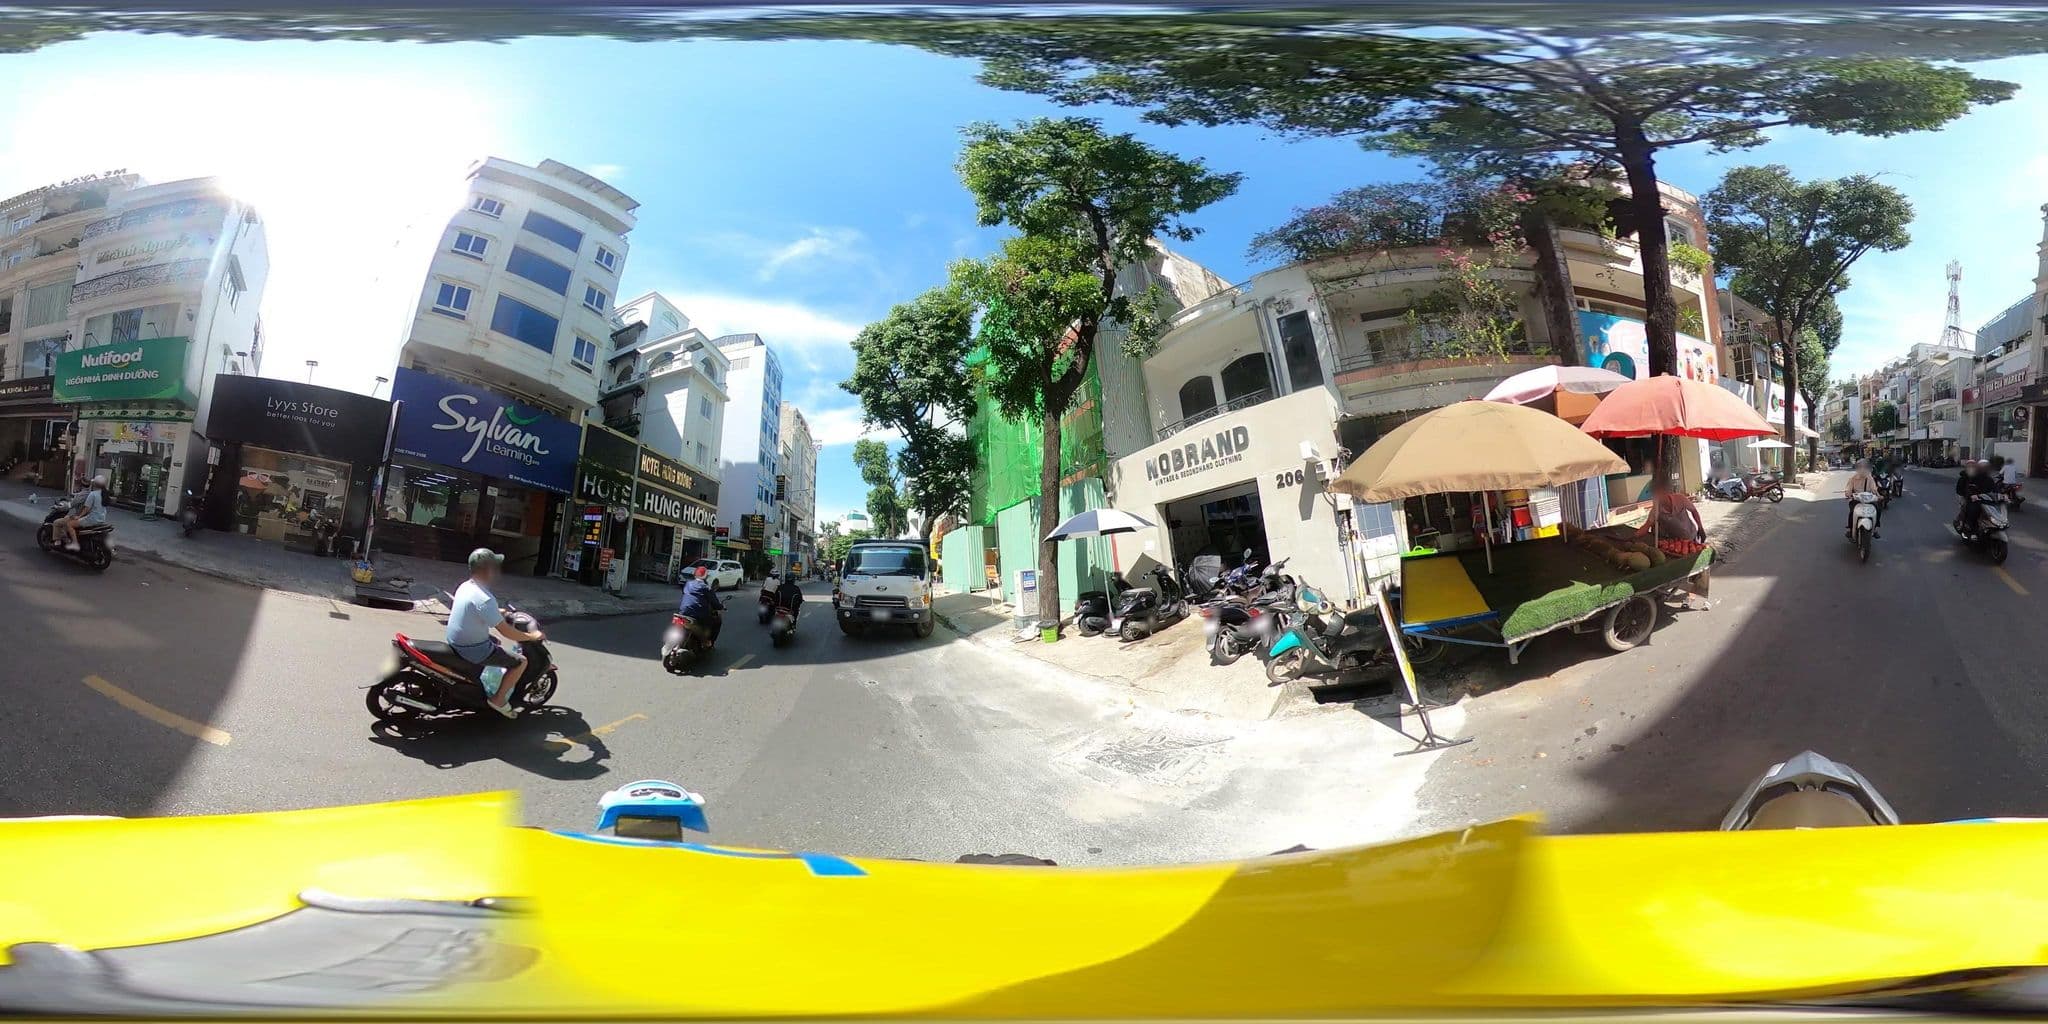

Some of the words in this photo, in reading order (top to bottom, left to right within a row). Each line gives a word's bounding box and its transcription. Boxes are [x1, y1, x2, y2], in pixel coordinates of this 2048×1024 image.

[81, 346, 143, 369] Nutifood
[102, 372, 124, 382] DINH
[267, 396, 297, 412] Lyys
[302, 402, 338, 418] Store
[266, 411, 290, 419] better
[292, 415, 307, 423] look
[309, 417, 320, 425] for
[321, 420, 336, 428] you
[432, 394, 549, 463] Sylvan
[486, 440, 533, 466] Learning
[1145, 425, 1250, 481] NOBRAND
[641, 454, 660, 477] HOTEL
[1155, 474, 1175, 487] VINTAGE
[1180, 462, 1213, 479] SECONDHAND
[1215, 453, 1242, 468] CLOTHING
[1275, 469, 1304, 489] 206
[644, 492, 680, 518] HƯNG
[683, 504, 717, 528] HƯƠNG
